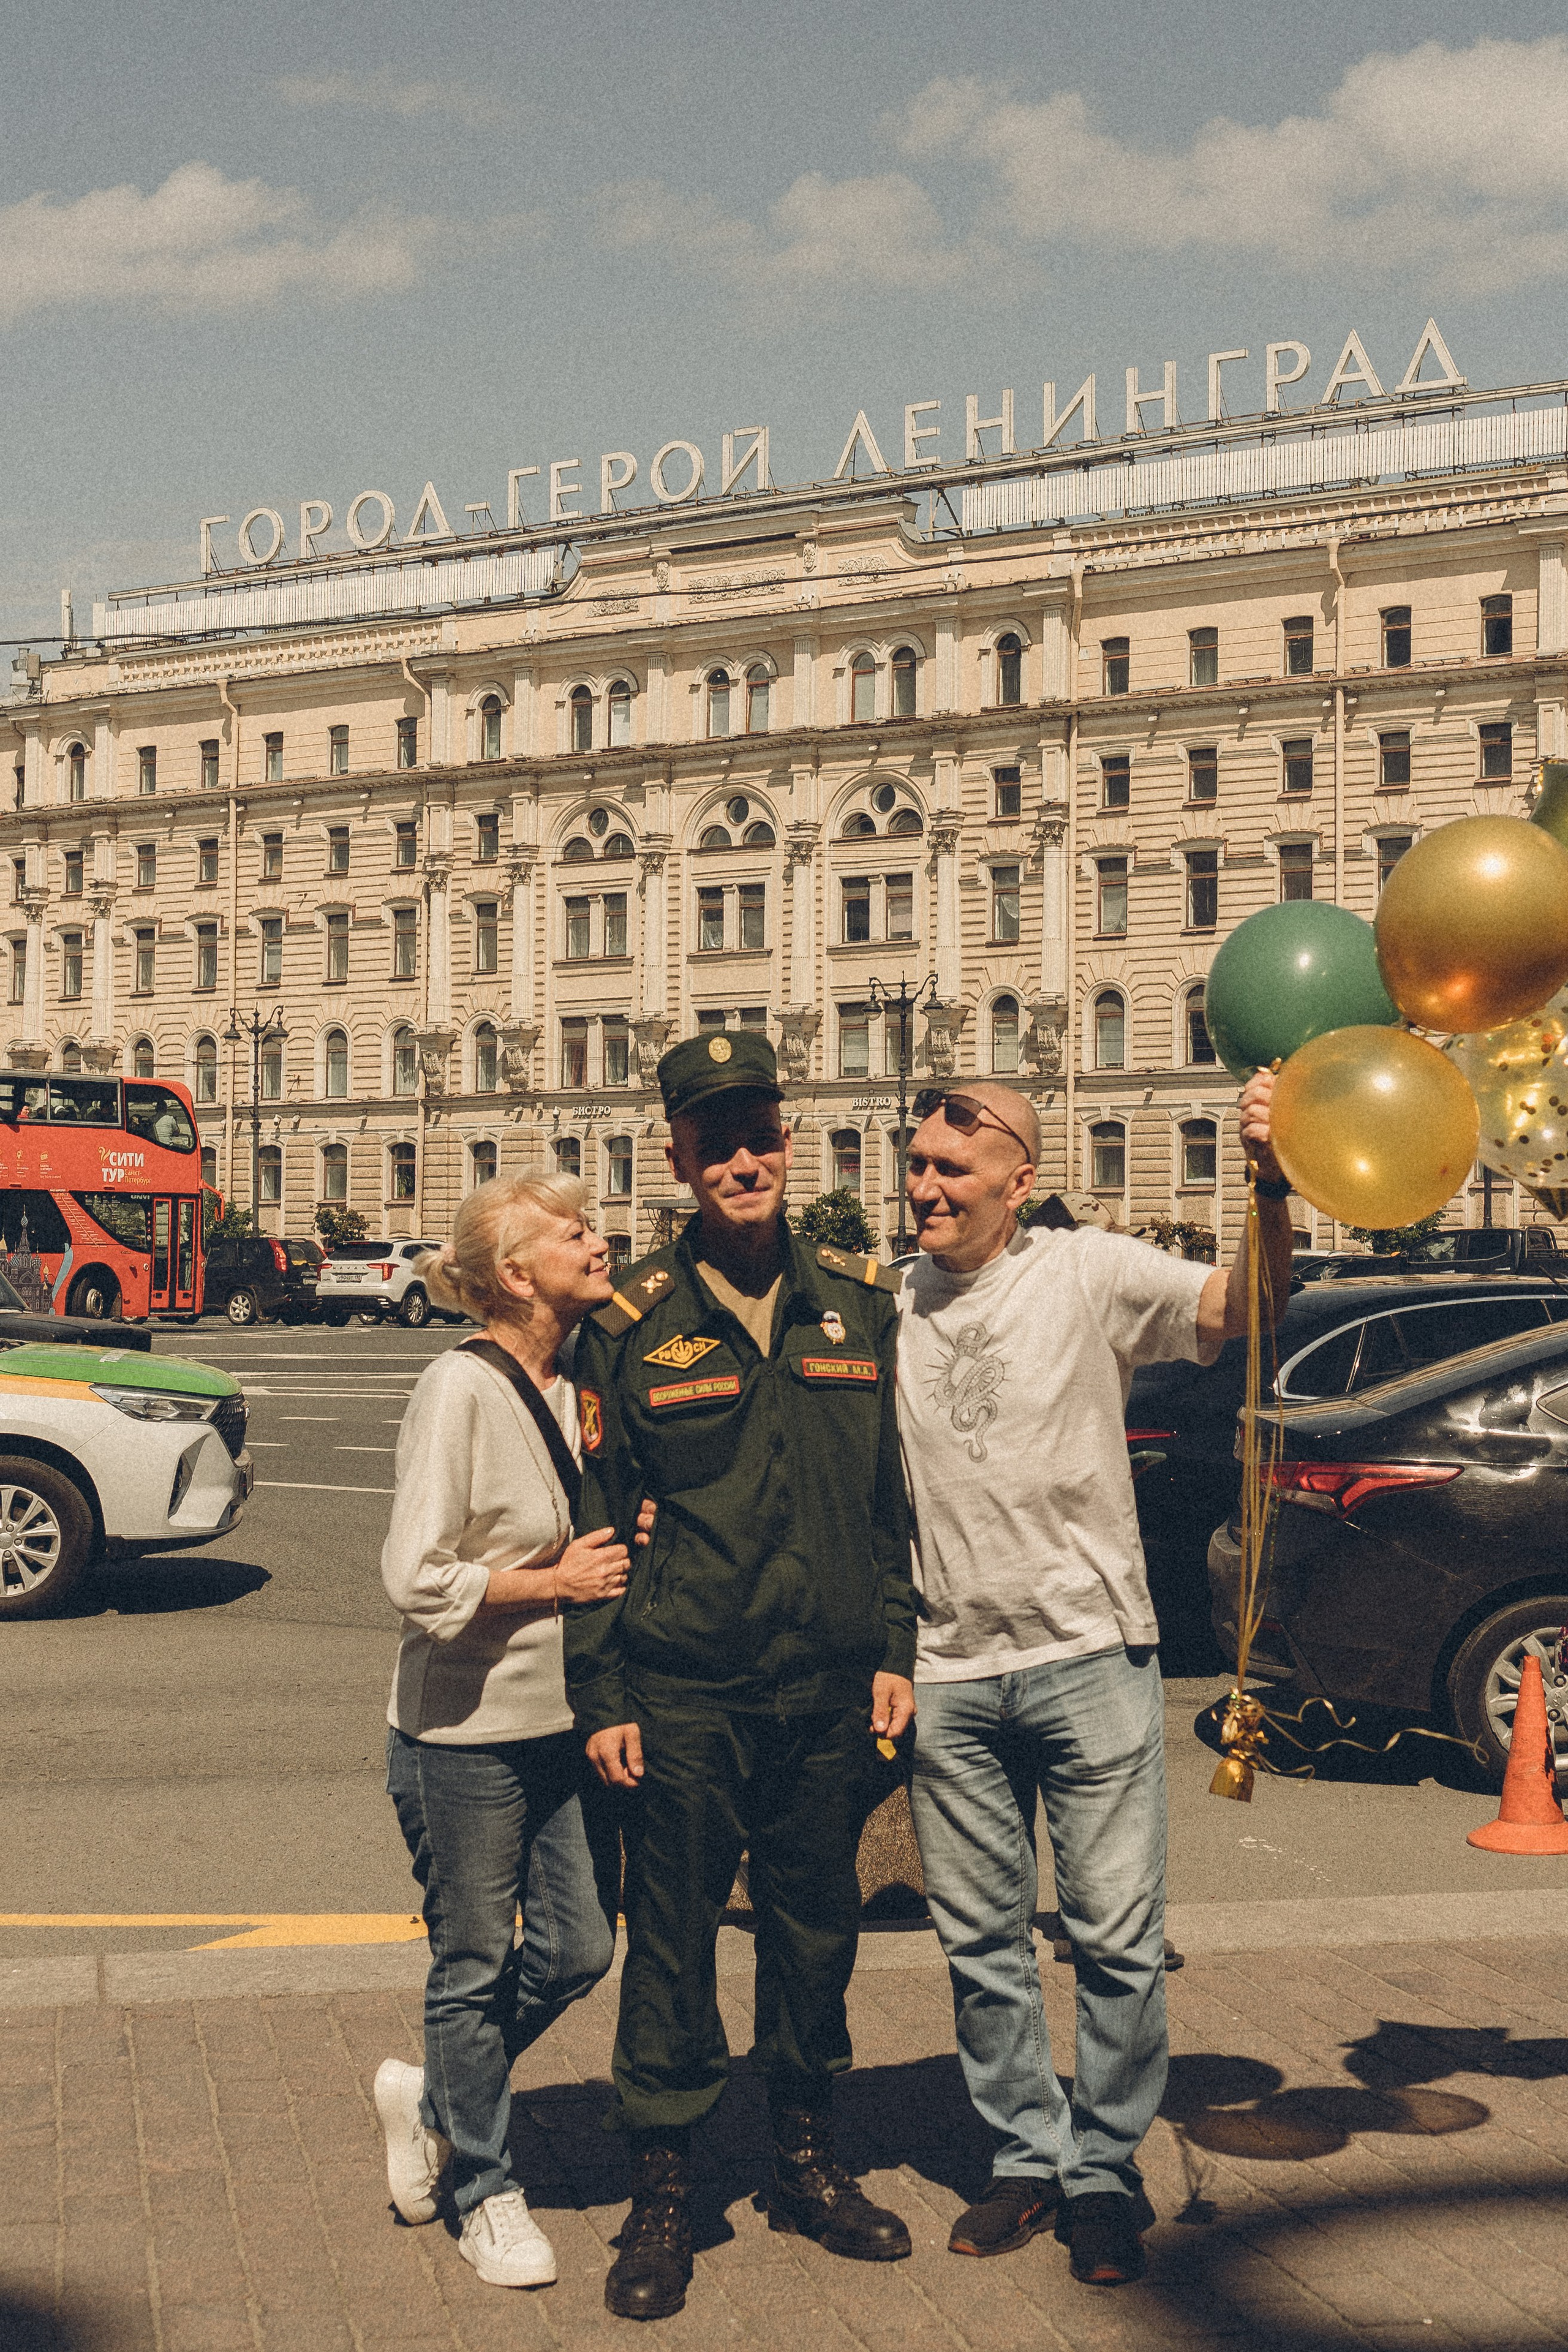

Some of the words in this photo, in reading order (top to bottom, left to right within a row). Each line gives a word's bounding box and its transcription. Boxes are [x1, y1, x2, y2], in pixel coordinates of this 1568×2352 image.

[200, 425, 770, 573] ГОРОД-ГЕРОЙ
[833, 317, 1467, 480] ЛЕНИНГРАД
[853, 1096, 891, 1107] BISTRO
[572, 1106, 611, 1115] БИСТРО
[109, 1152, 145, 1167] СИТИ
[101, 1167, 125, 1183] ТУР
[124, 1176, 152, 1185] Петербург
